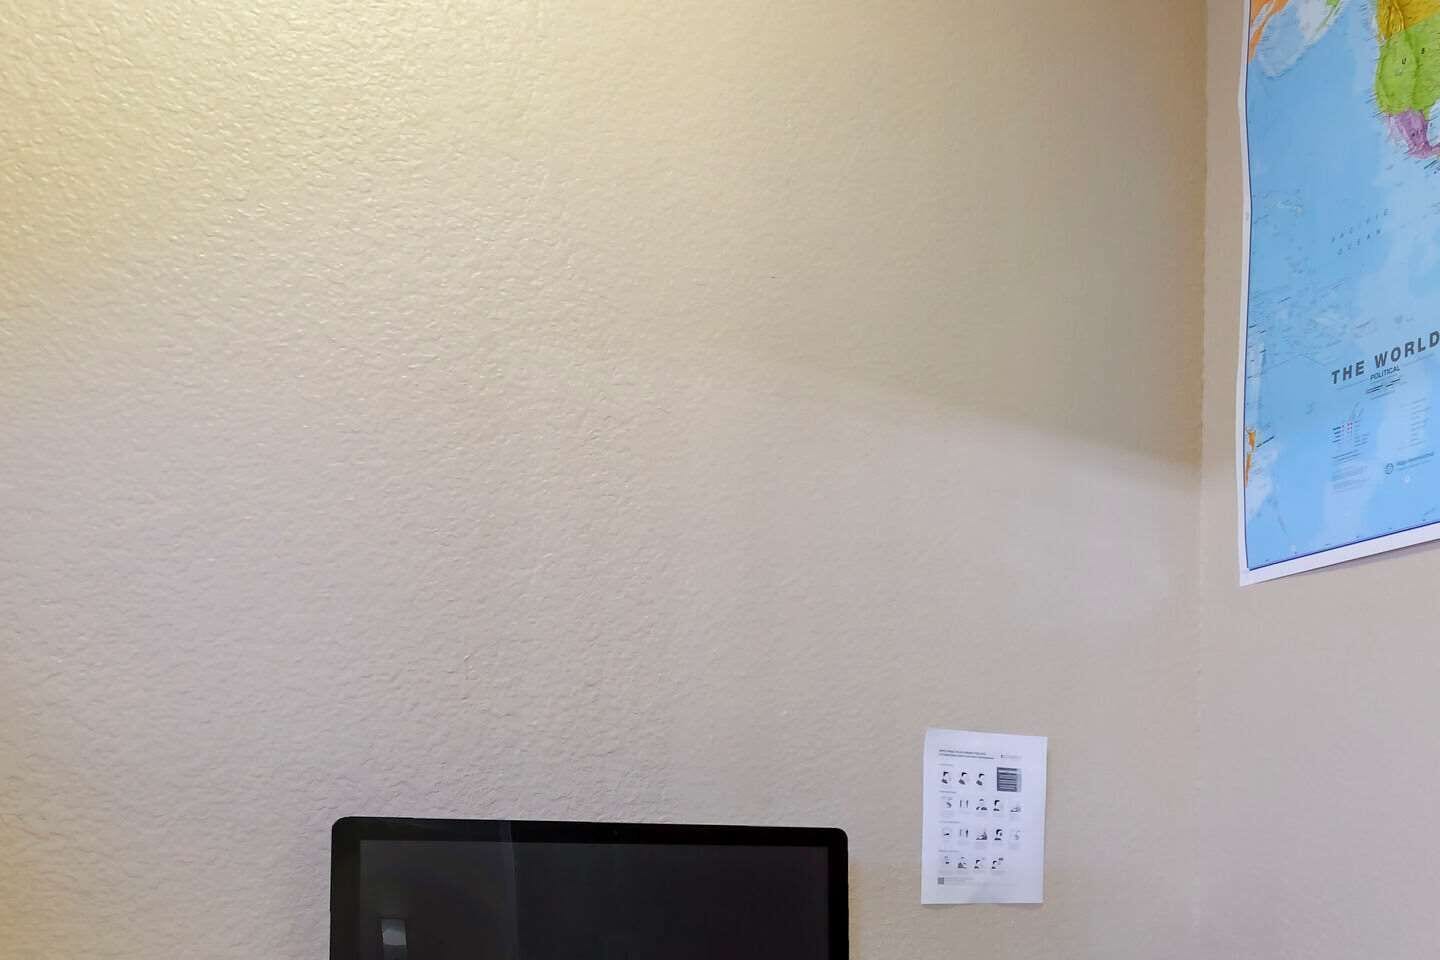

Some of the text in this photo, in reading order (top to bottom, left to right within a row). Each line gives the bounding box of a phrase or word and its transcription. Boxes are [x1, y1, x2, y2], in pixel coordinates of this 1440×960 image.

[1331, 330, 1440, 384] THE WORLD
[1370, 365, 1400, 380] POLITICAL
